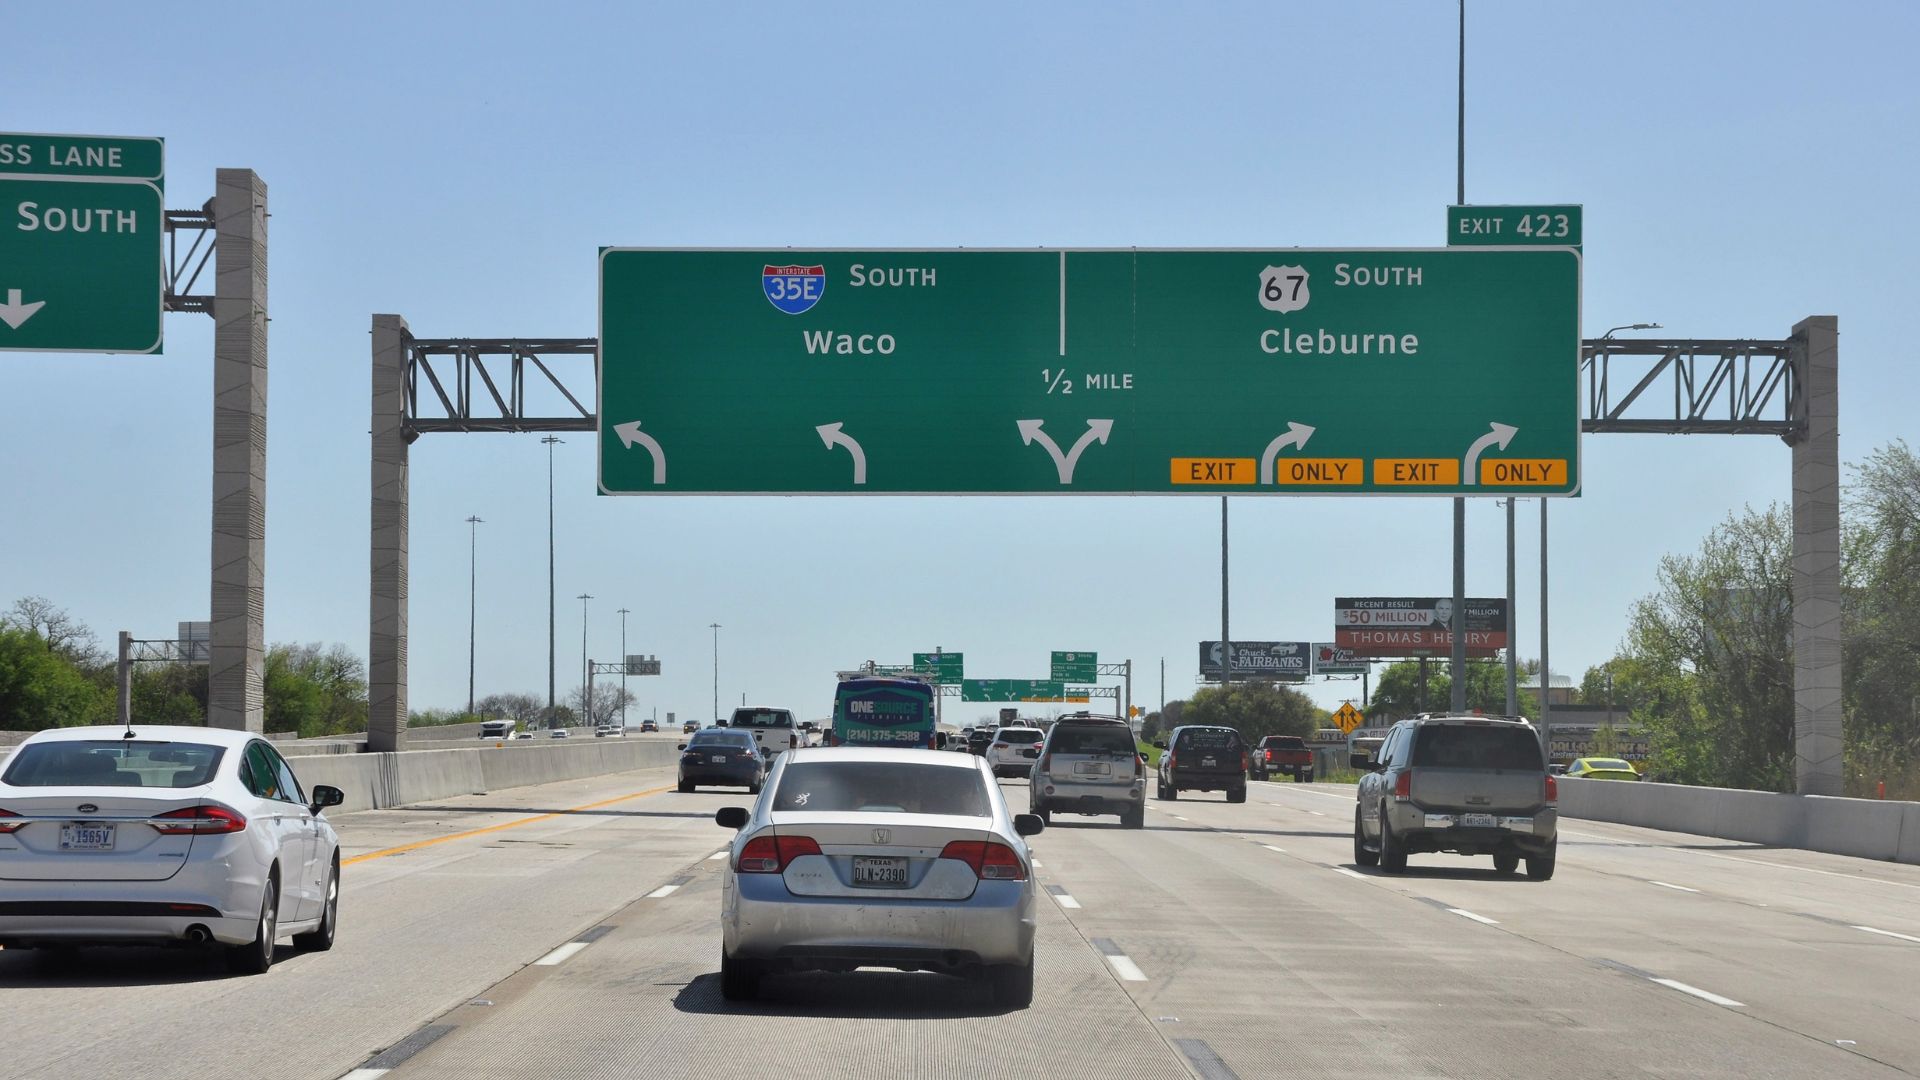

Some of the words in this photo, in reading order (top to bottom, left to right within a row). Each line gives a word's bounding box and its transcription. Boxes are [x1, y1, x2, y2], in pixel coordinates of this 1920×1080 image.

[50, 145, 122, 168] LANE
[17, 201, 137, 233] SOUTH
[1460, 218, 1504, 234] EXIT
[1516, 214, 1569, 237] 423
[776, 267, 812, 275] INTERSTATE
[849, 264, 937, 287] SOUTH
[1334, 263, 1423, 286] SOUTH
[770, 277, 818, 300] 35E
[1264, 276, 1305, 302] 67
[803, 330, 897, 355] Waco
[1260, 328, 1419, 355] Cleburne
[1086, 374, 1133, 389] MILE
[1190, 463, 1236, 481] EXIT
[1291, 463, 1349, 481] ONLY
[1393, 463, 1440, 481] EXIT
[1495, 463, 1553, 482] ONLY
[1343, 610, 1371, 624] $50
[1375, 612, 1427, 622] MILLION
[1351, 632, 1422, 643] THOMAS
[1239, 649, 1267, 657] Chuck
[1239, 656, 1303, 668] FAIRBANKS
